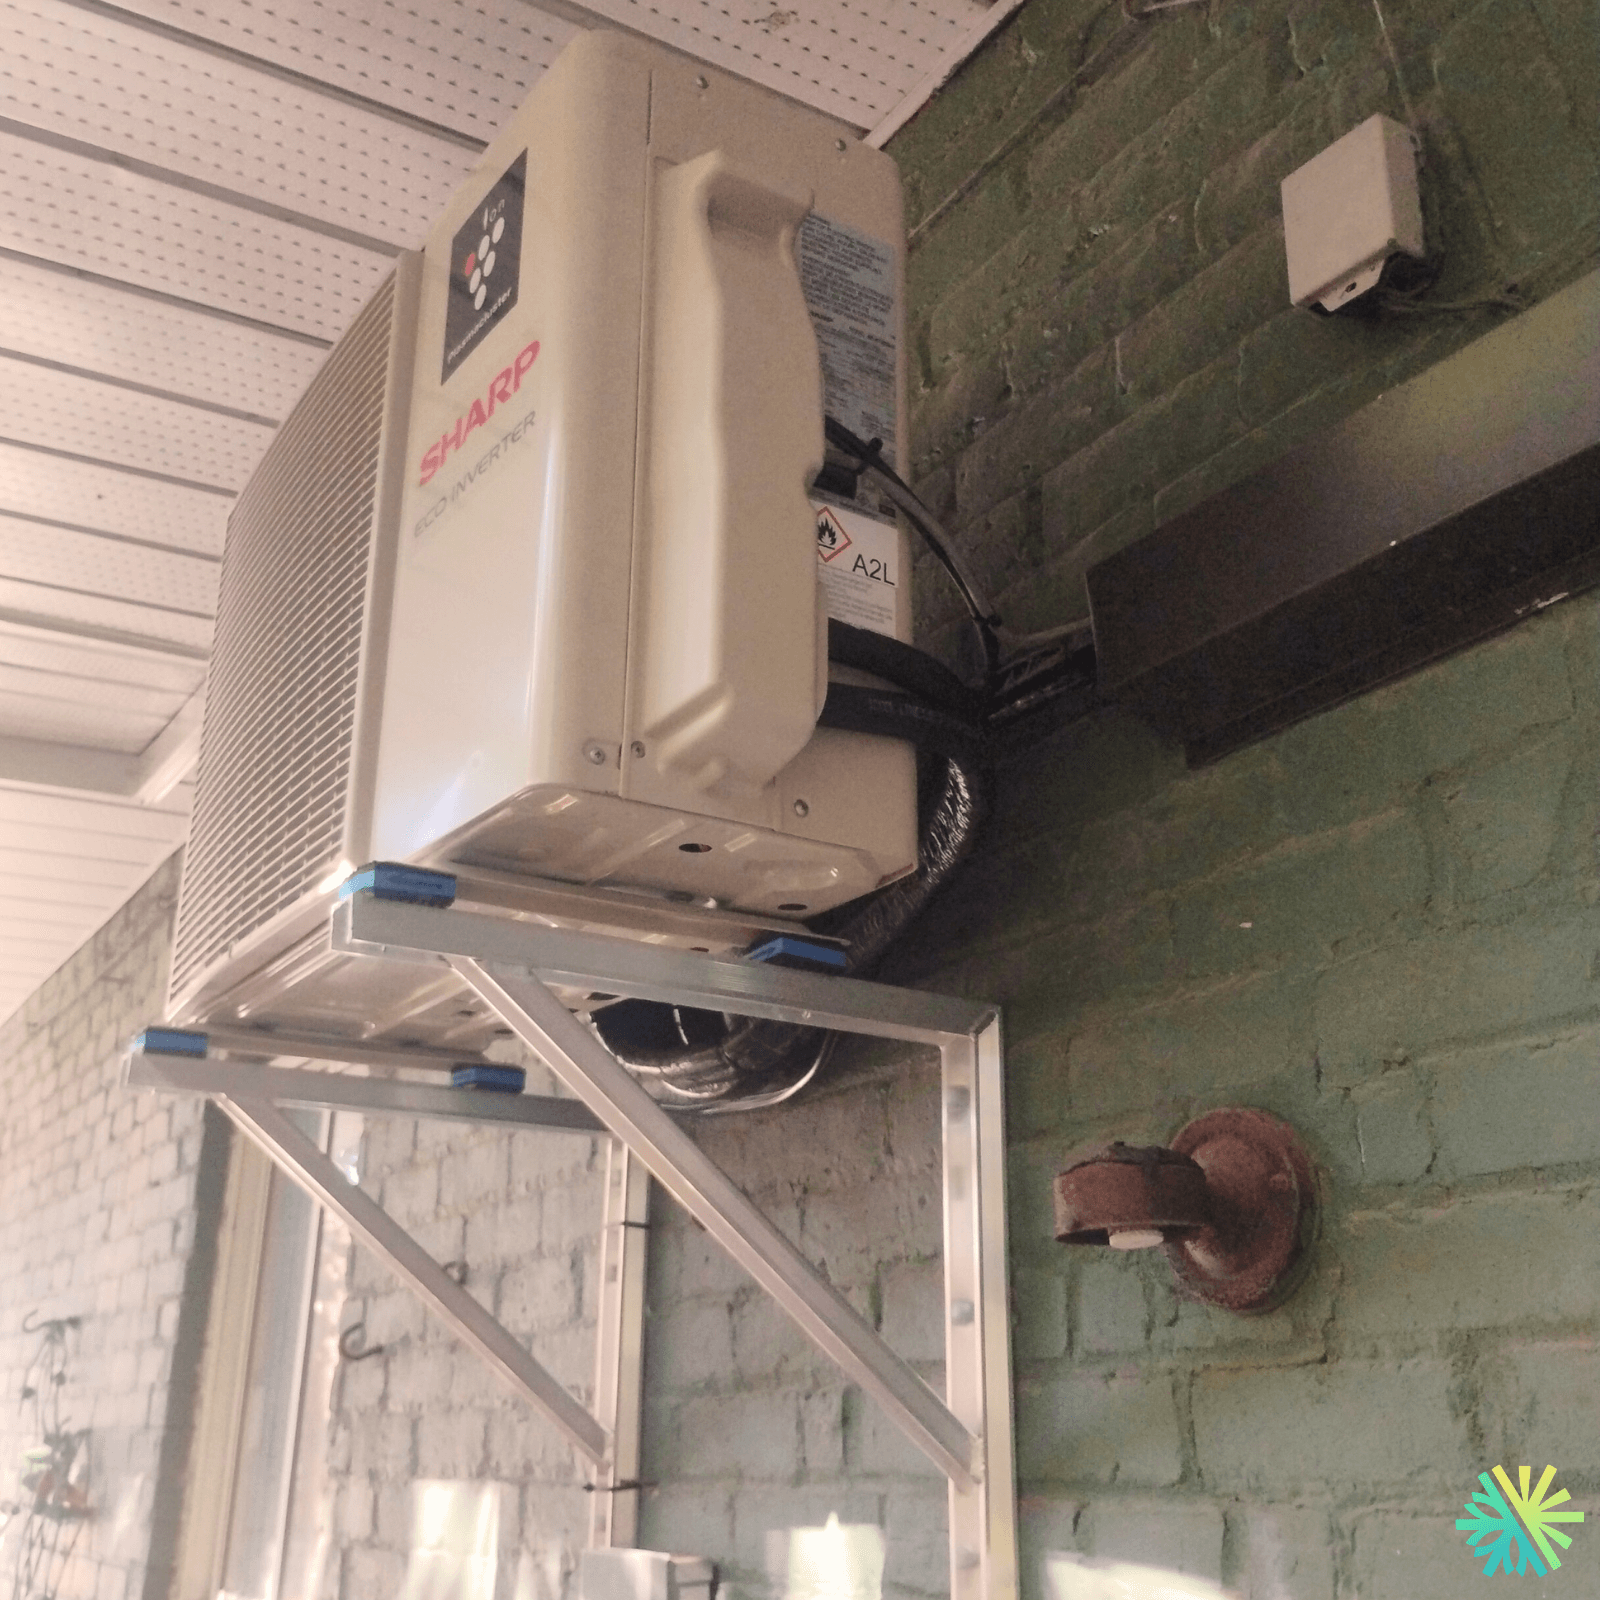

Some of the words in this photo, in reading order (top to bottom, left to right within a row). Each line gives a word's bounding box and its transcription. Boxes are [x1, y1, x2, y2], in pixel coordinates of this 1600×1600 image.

[413, 496, 447, 538] ECO
[452, 410, 536, 502] INVERTER
[419, 339, 541, 487] SHARP
[852, 553, 895, 586] A2L
